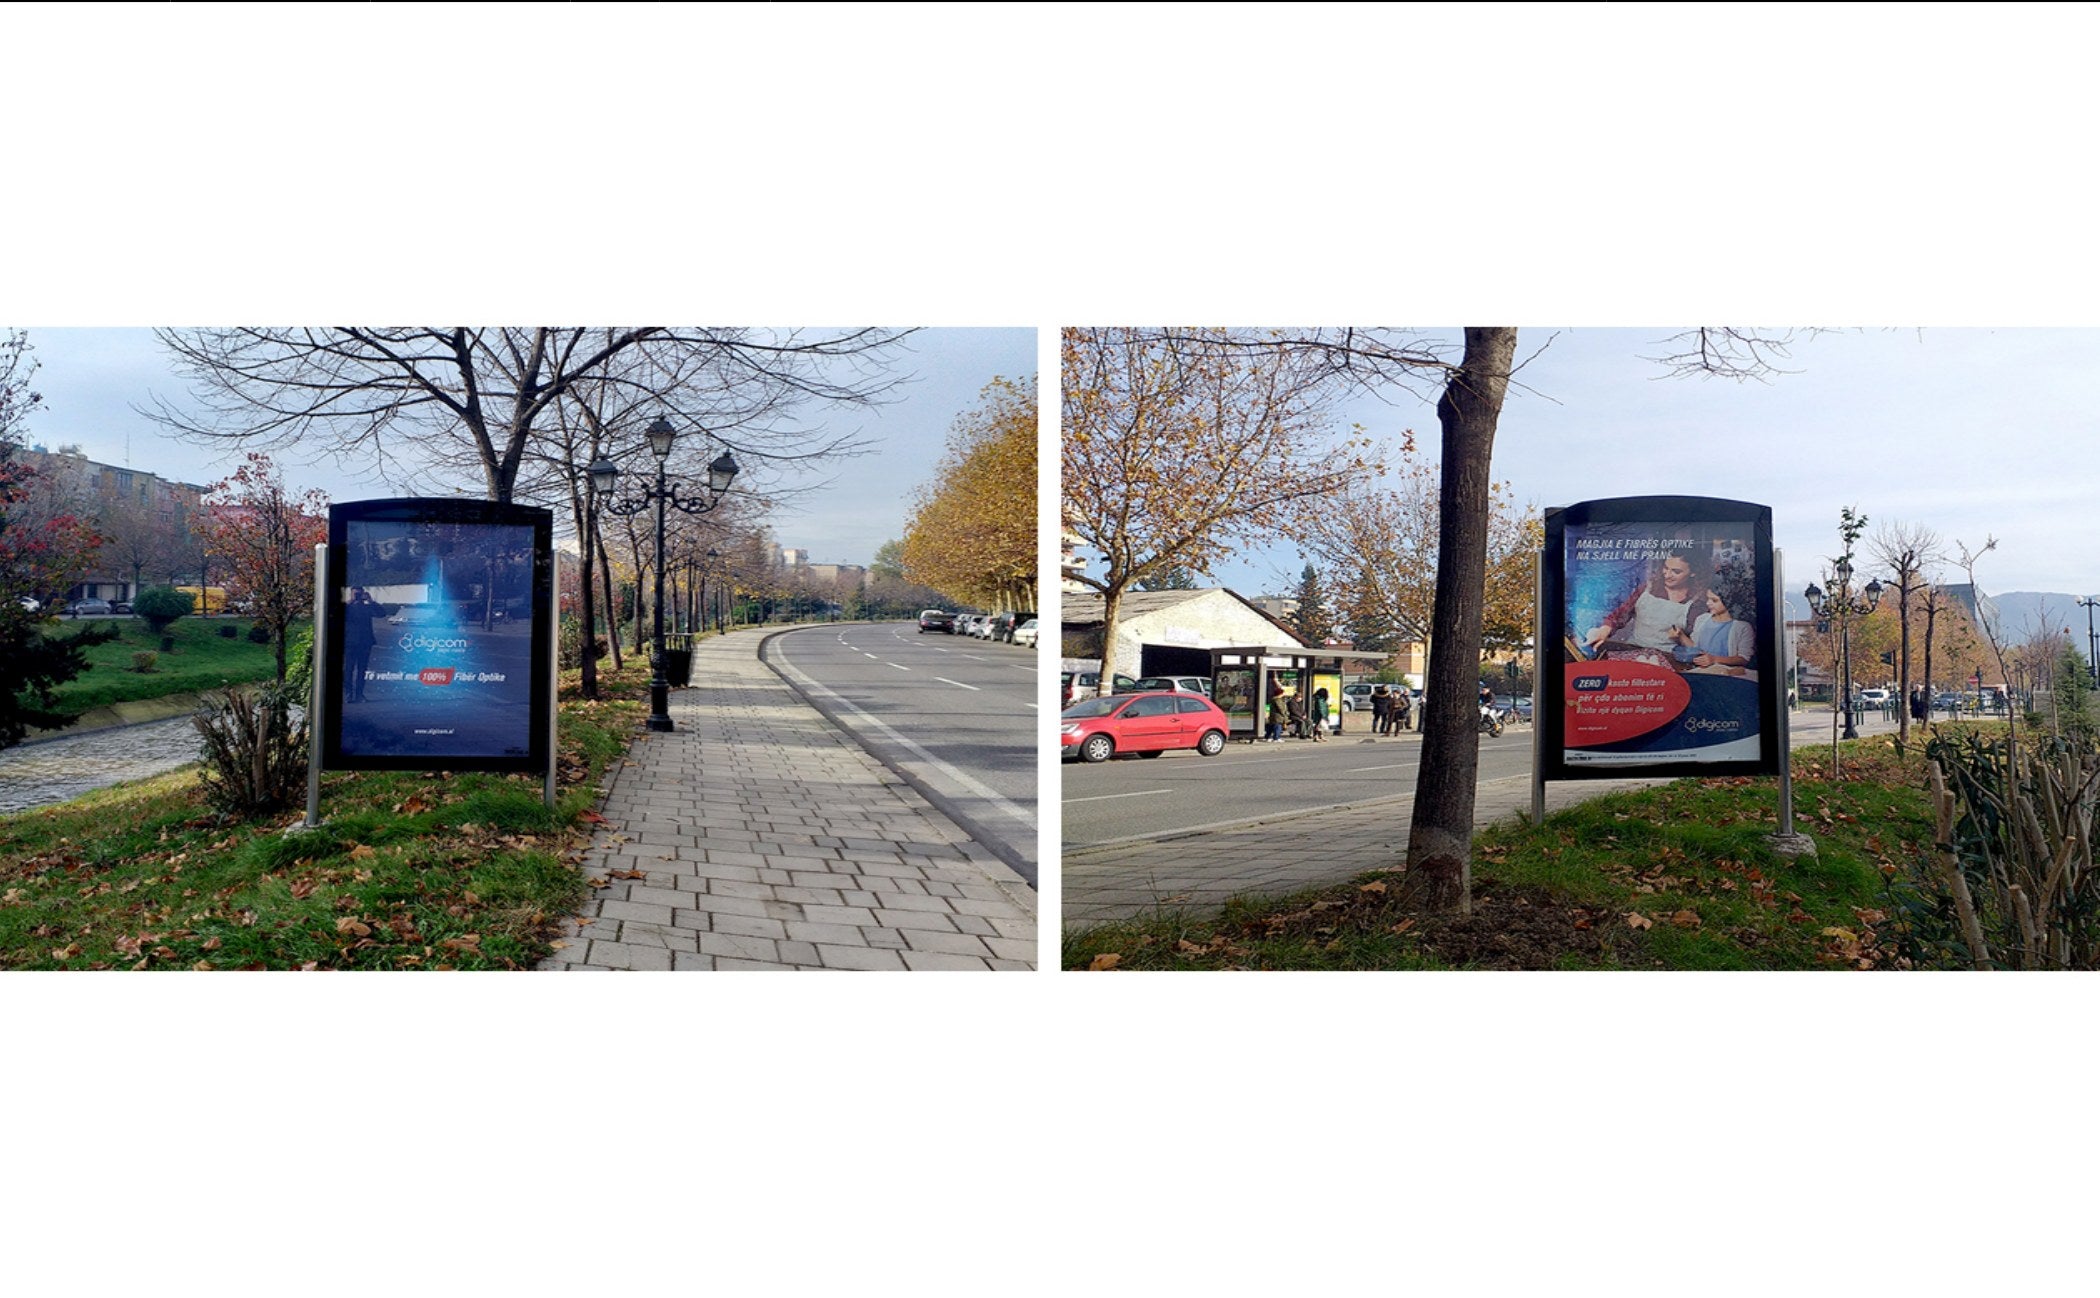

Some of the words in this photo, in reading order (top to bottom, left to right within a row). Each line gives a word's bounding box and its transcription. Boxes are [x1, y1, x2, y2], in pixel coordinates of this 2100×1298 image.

[1576, 539, 1613, 549] MAGJIA
[1616, 539, 1623, 549] E
[1660, 539, 1694, 549] OPTIKE
[1576, 551, 1589, 560] NA
[1591, 550, 1620, 560] SJELL
[413, 634, 467, 652] digicom
[364, 671, 375, 680] Të
[422, 672, 447, 681] 100%
[477, 672, 506, 683] Optike
[1578, 679, 1601, 688] ZERO
[1635, 705, 1664, 713] Digicom
[1696, 718, 1739, 731] digicom
